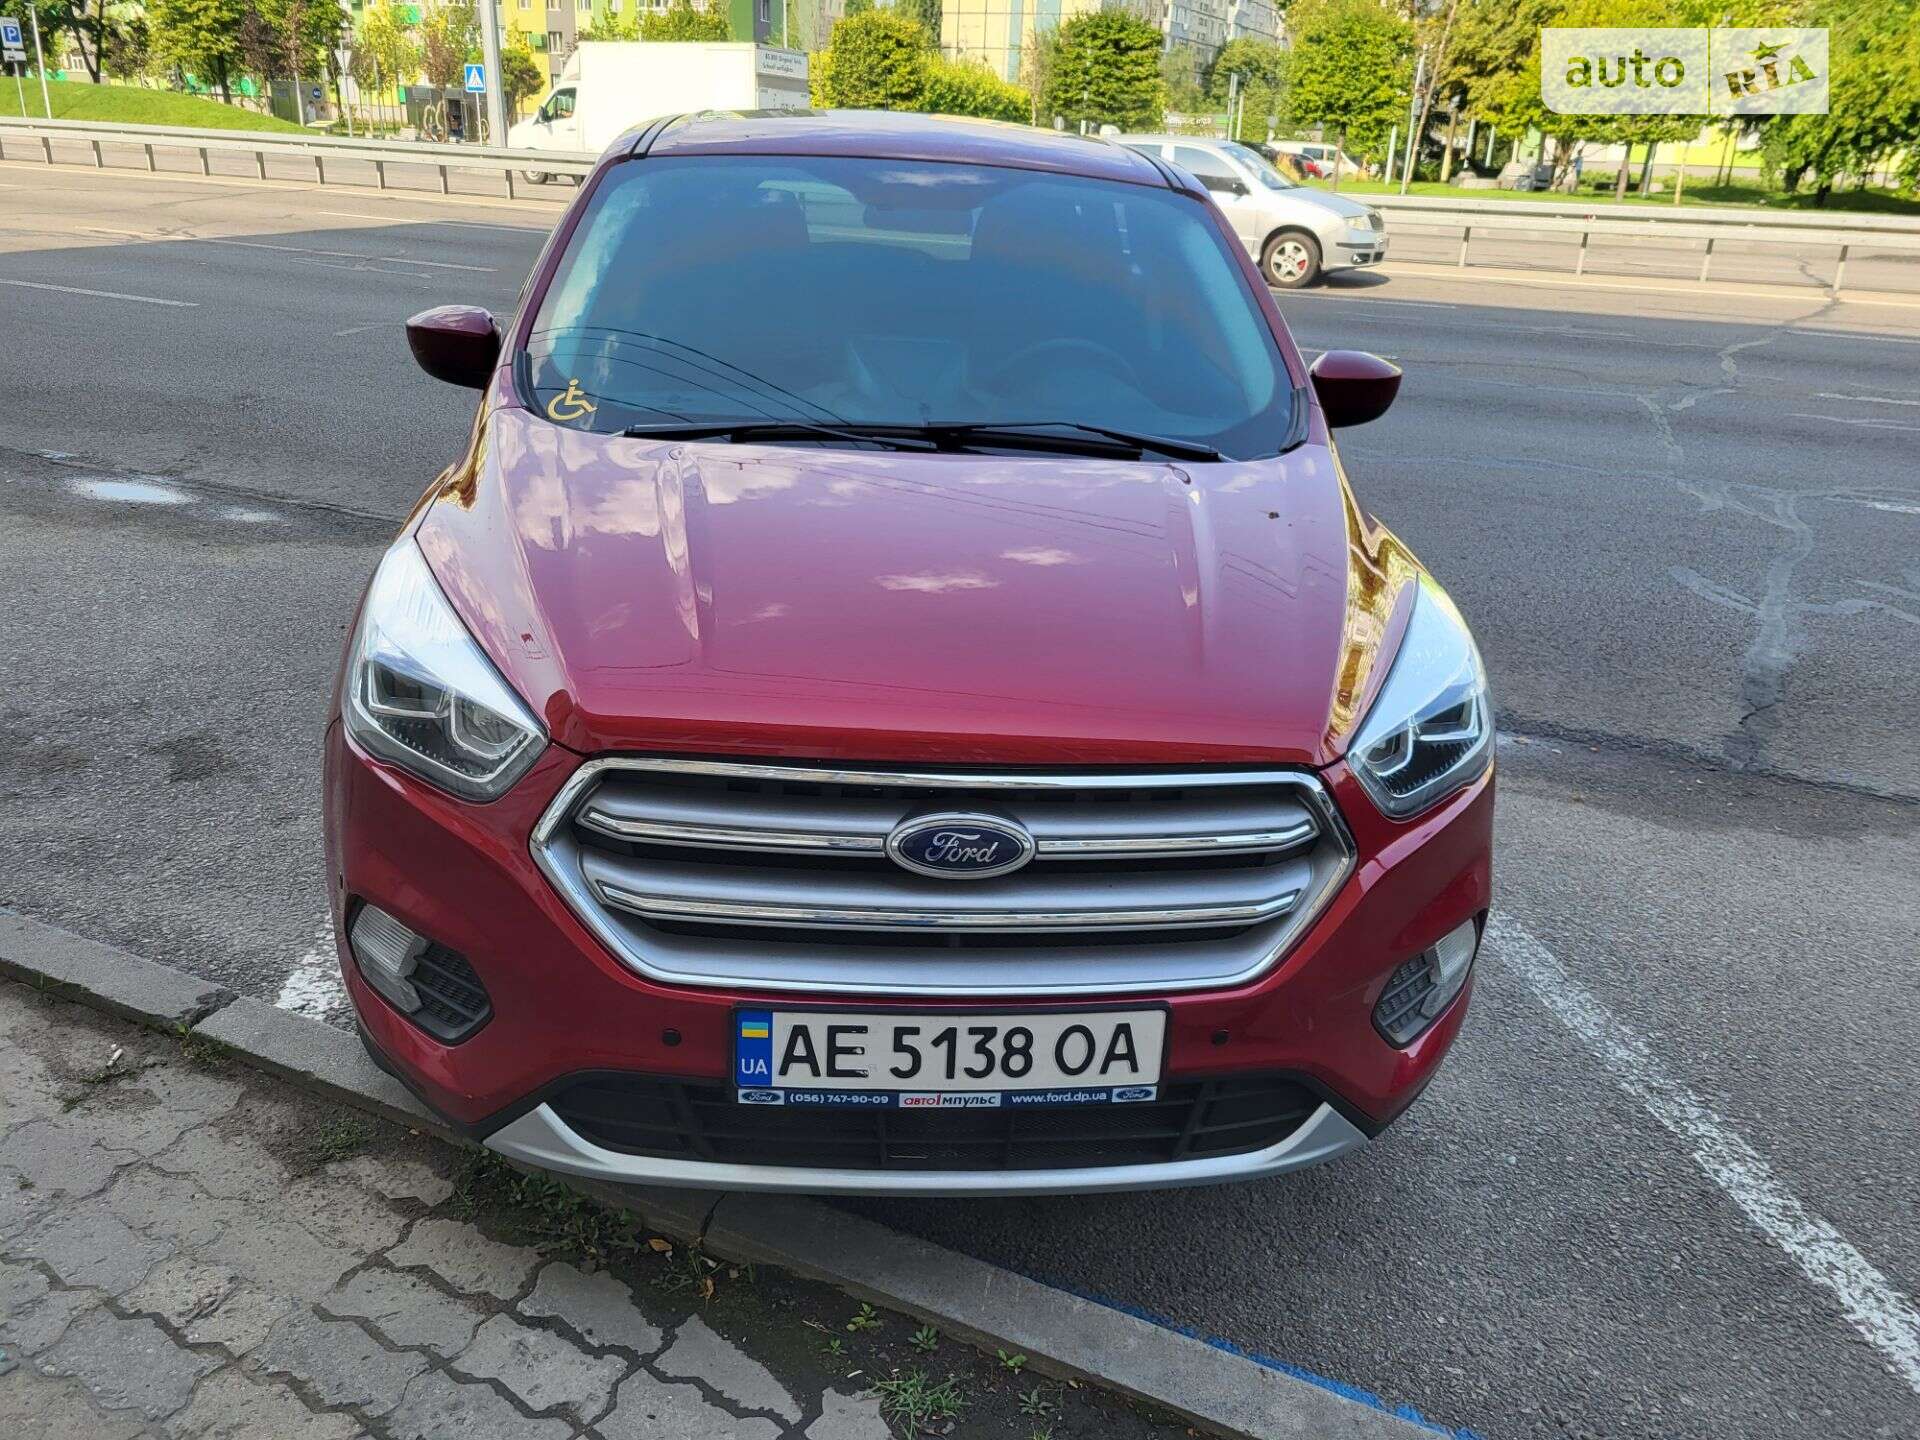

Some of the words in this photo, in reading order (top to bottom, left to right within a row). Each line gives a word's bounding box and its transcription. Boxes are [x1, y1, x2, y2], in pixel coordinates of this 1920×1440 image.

[925, 832, 999, 862] Ford
[778, 1024, 869, 1078] AE
[889, 1026, 1034, 1079] 5138
[1054, 1023, 1140, 1076] OA
[742, 1060, 768, 1075] UA
[748, 1092, 773, 1101] Ford
[789, 1094, 825, 1104] (056)
[827, 1094, 889, 1104] 747-90-09
[1011, 1091, 1107, 1104] www.ford.dp.ua
